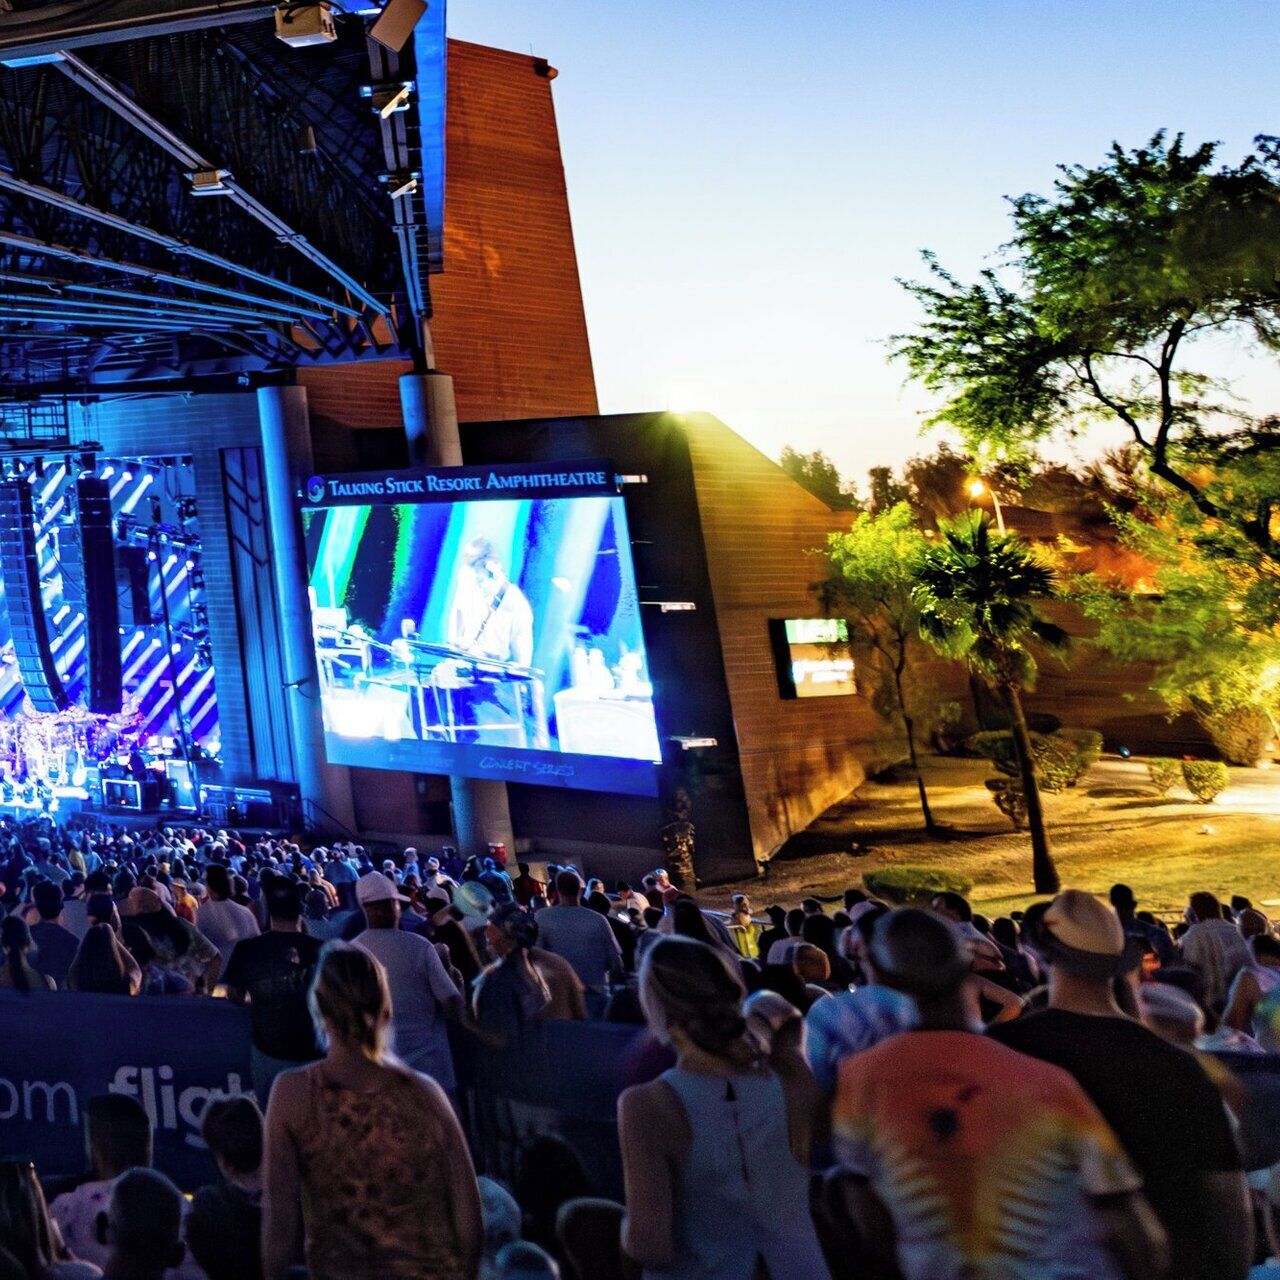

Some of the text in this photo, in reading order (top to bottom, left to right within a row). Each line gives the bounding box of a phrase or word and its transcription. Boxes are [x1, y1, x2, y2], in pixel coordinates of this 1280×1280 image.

[328, 470, 607, 497] TALKING STICK RESORT AMPHITHEATRE
